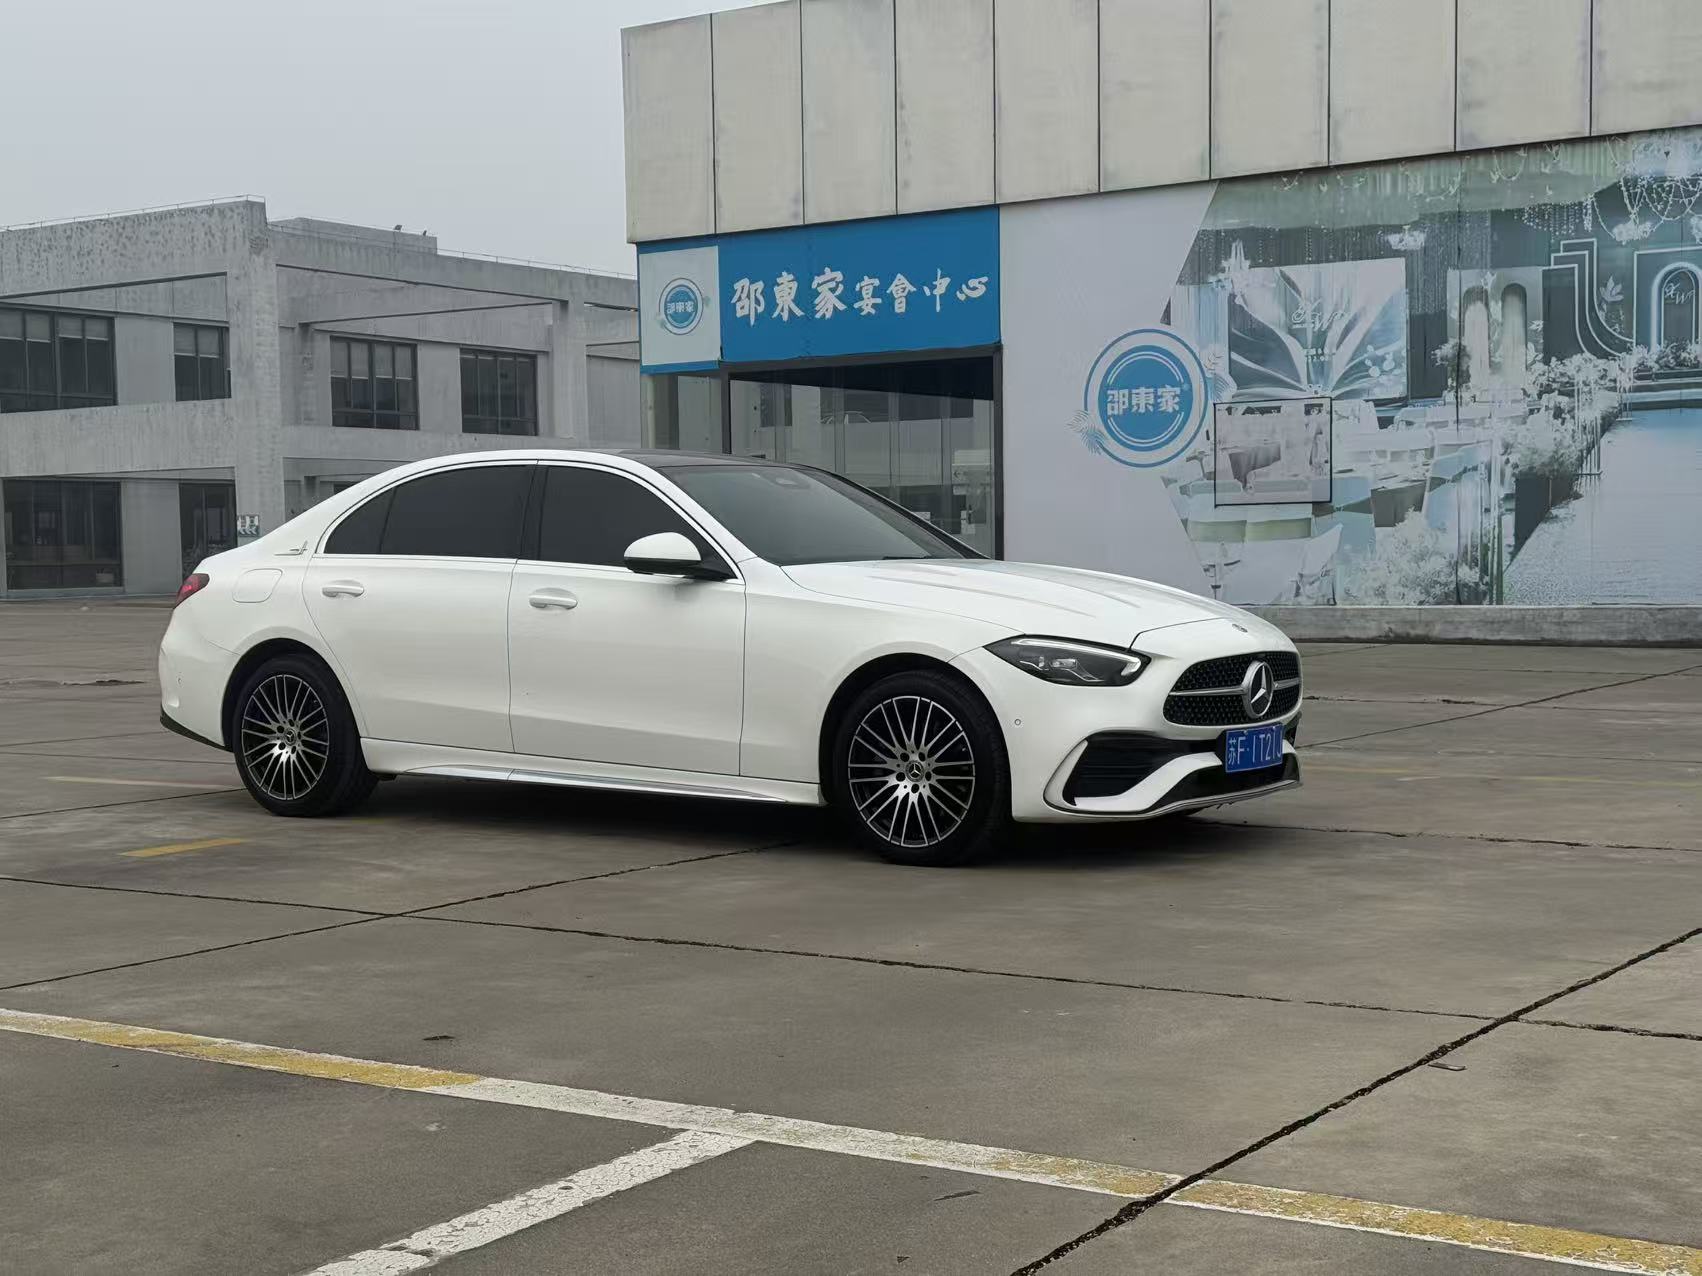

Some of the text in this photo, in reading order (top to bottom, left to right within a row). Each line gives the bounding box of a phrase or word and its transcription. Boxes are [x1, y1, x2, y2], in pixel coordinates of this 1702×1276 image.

[731, 267, 989, 326] 邵東家宴會中心
[1106, 384, 1181, 416] 邵東家
